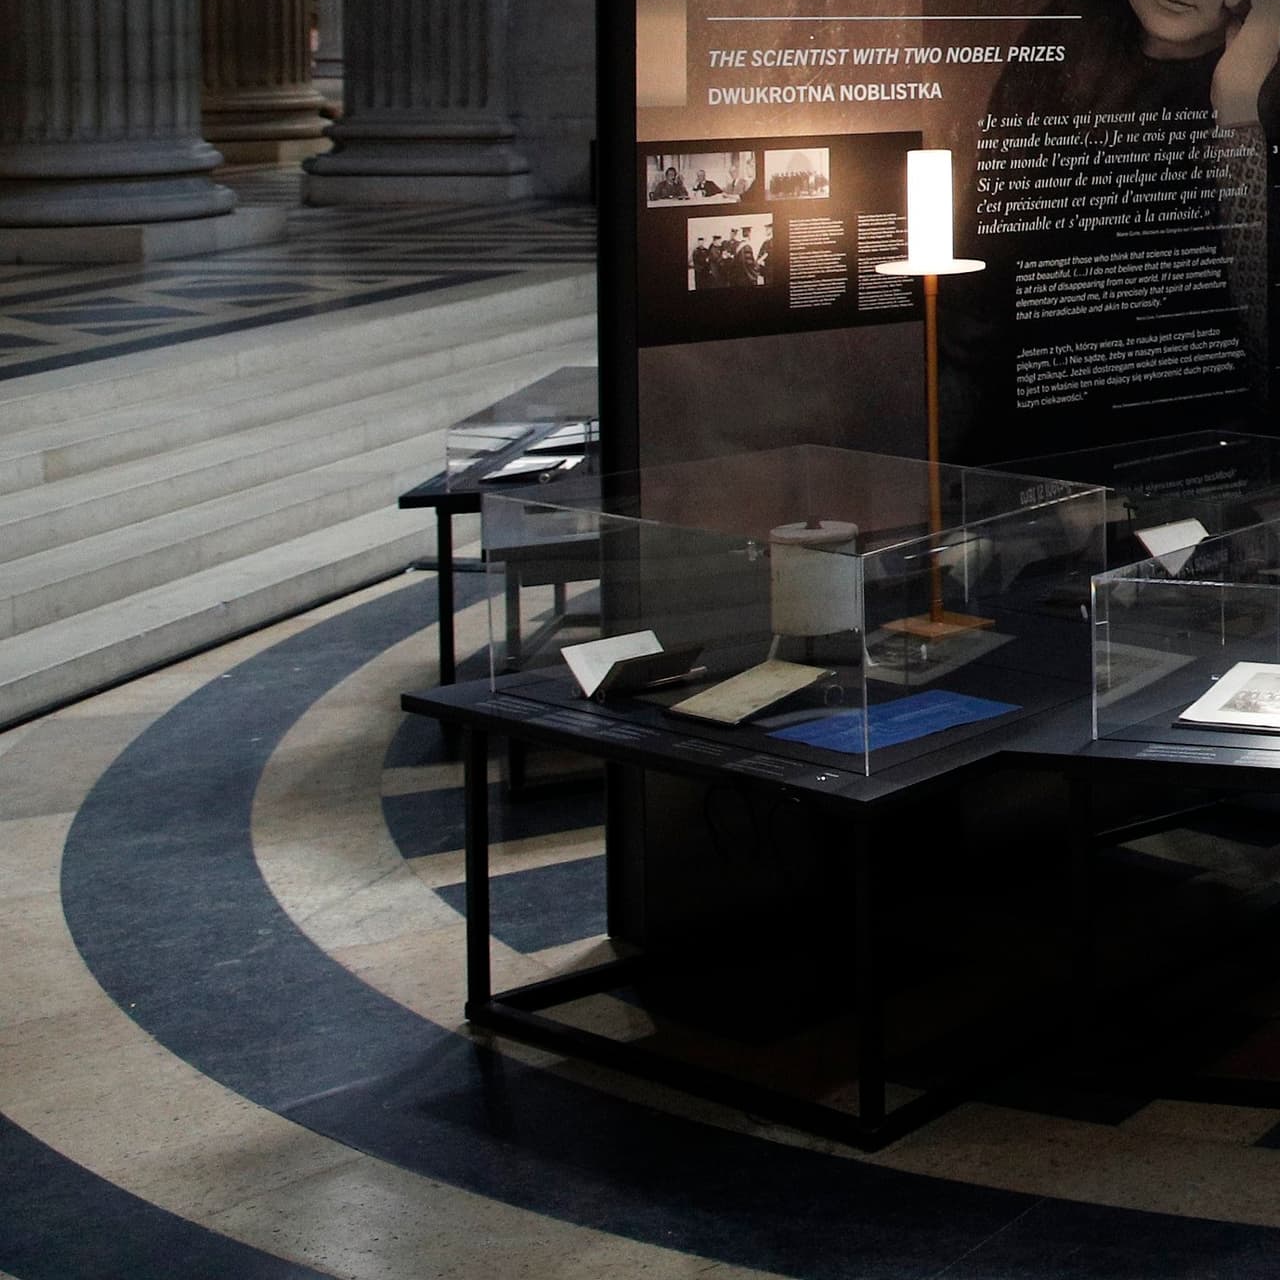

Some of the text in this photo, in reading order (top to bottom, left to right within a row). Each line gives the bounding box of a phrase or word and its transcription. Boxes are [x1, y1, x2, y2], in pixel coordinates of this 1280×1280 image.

[709, 45, 1065, 68] THE SCIENTIST WITH TWO NOBEL PRIZES
[708, 83, 943, 105] DWUKROTNA NOBLISTKA
[1001, 113, 1023, 128] suis
[1027, 112, 1040, 127] de
[1043, 114, 1070, 126] ceux
[1073, 110, 1092, 128] qui
[1094, 111, 1136, 128] pensent
[1139, 111, 1158, 126] que
[1162, 107, 1172, 120] la
[1175, 107, 1208, 120] science
[1212, 110, 1218, 119] a
[977, 138, 999, 149] une
[1001, 133, 1040, 153] grande
[1108, 130, 1124, 148] Je
[1127, 132, 1140, 143] ne
[1143, 129, 1166, 142] crois
[1168, 131, 1186, 144] pas
[1190, 129, 1209, 143] que
[1212, 125, 1236, 139] dans
[977, 160, 1007, 171] notre
[1010, 153, 1049, 169] monde
[1154, 148, 1185, 165] risque
[1188, 146, 1200, 160] de
[977, 164, 1232, 195] Si je vois autour de moi quelque chose de vital,
[1005, 196, 1069, 216] précisément
[1072, 196, 1086, 208] cet
[1090, 192, 1119, 210] esprit
[1180, 186, 1198, 204] qui
[1200, 188, 1217, 199] me
[978, 216, 1052, 235] indéracinable
[1055, 217, 1066, 230] et
[1134, 210, 1141, 223] à
[1145, 208, 1155, 223] la
